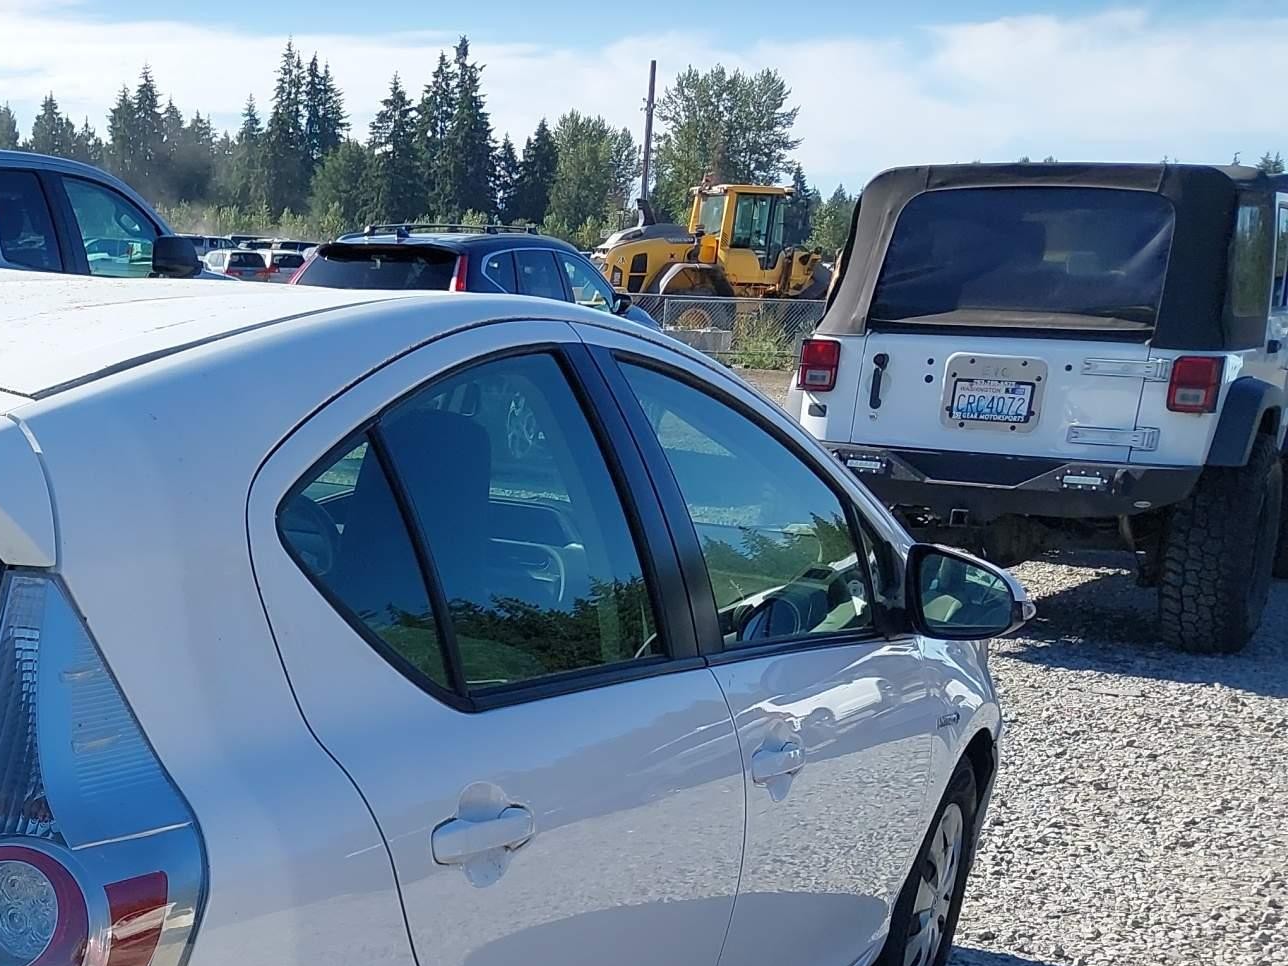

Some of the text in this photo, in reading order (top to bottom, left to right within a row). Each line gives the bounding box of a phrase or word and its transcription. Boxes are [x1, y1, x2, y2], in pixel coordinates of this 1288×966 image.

[956, 394, 1026, 416] CRC4072
[962, 412, 978, 420] GEAR
[979, 413, 1025, 422] MOTORSPORTS
